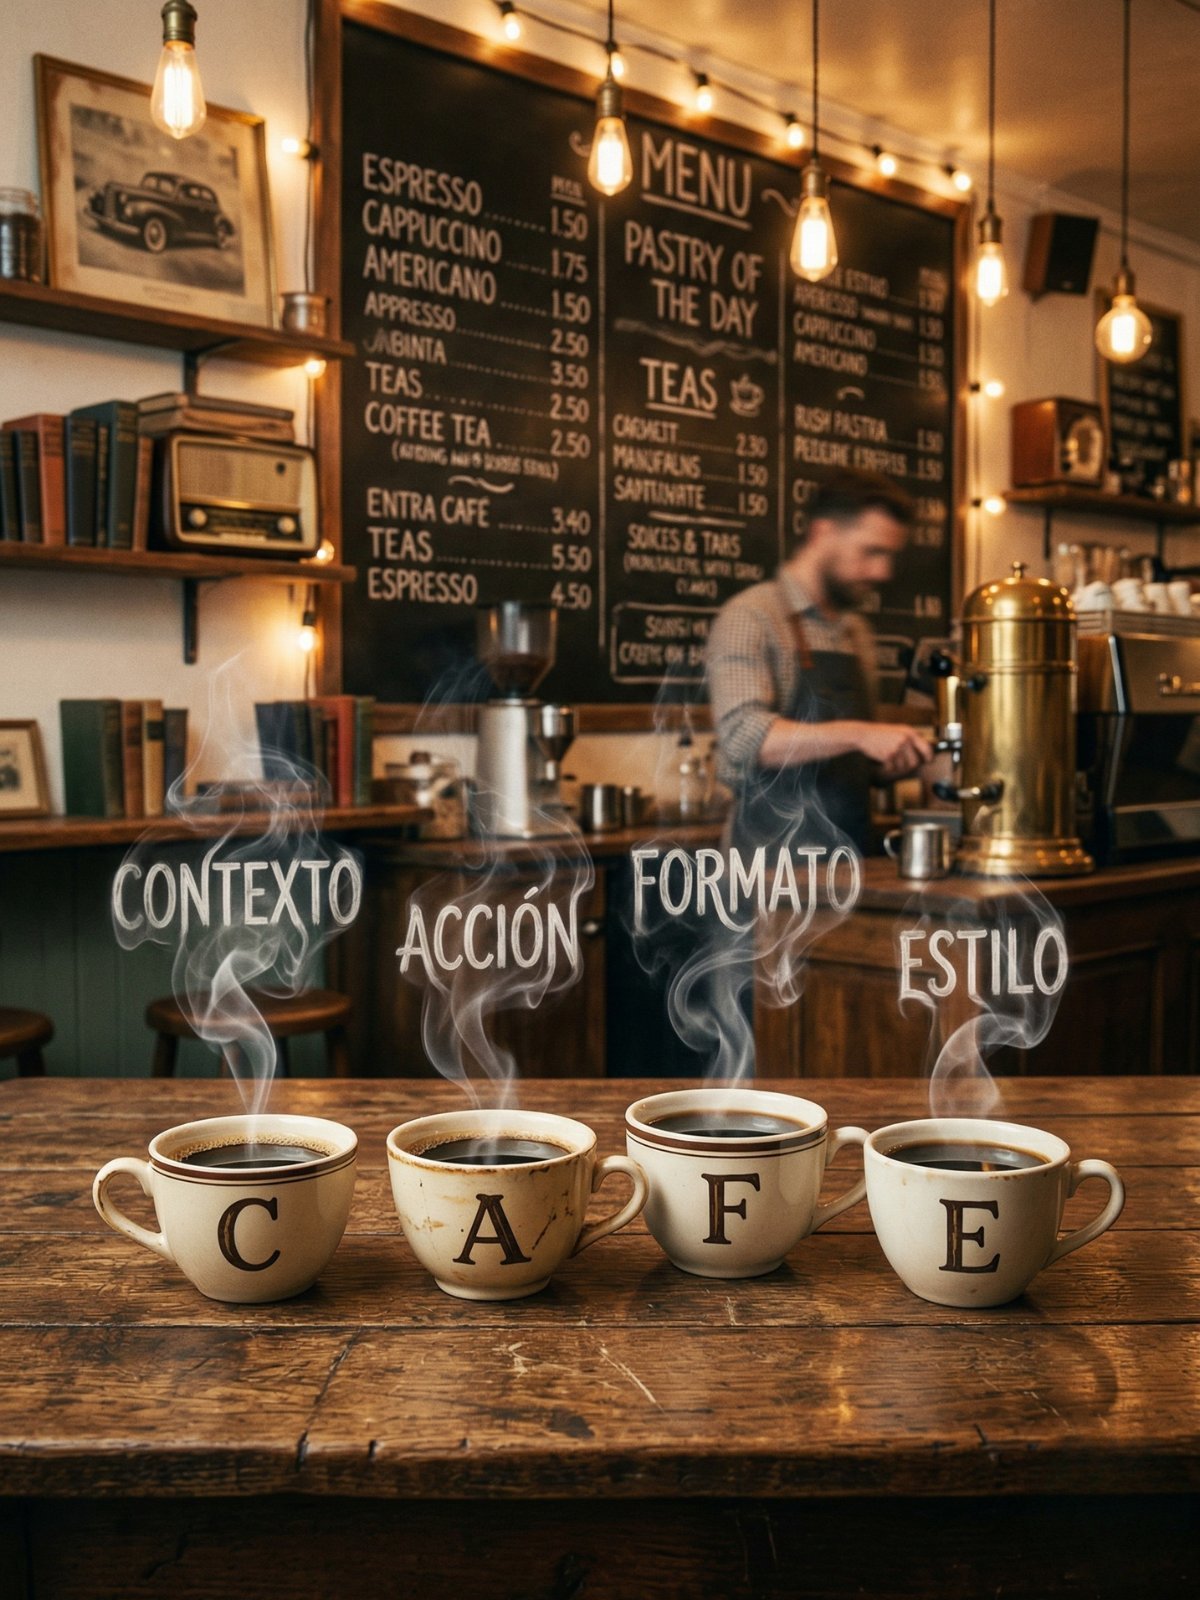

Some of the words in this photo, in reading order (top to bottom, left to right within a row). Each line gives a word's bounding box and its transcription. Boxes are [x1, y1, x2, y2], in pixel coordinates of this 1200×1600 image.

[362, 152, 483, 217] ESPRESSO
[551, 205, 589, 242] 1.50
[640, 130, 752, 218] MENU
[362, 199, 502, 264] CAPPUCCINO
[551, 248, 589, 284] 1.75
[624, 220, 725, 286] PASTRY
[731, 251, 764, 294] OF
[362, 243, 497, 305] AMERICANO
[551, 289, 592, 325] 1.50
[651, 277, 701, 328] THE
[708, 290, 759, 339] DAY
[363, 290, 457, 333] APPRESSO
[551, 328, 590, 359] 2.50
[365, 361, 424, 400] TEAS
[551, 392, 590, 423] 2.50
[551, 360, 590, 389] 3.50
[639, 356, 719, 411] TEAS
[365, 400, 446, 442] COFFEE
[450, 412, 492, 449] TEA
[551, 428, 592, 459] 2.50
[366, 486, 438, 525] ENTRA
[551, 506, 592, 536] 3.40
[366, 525, 435, 564] TEAS
[551, 542, 593, 573] 5.50
[367, 566, 479, 605] ESPRESSO
[551, 581, 593, 610] 4.50
[112, 857, 363, 935] CONTEXTO
[631, 845, 862, 935] FORMATO
[395, 886, 579, 975] ACCIÓN
[899, 926, 1070, 1002] ESTILO
[217, 1196, 281, 1272] C
[452, 1193, 532, 1266] A
[700, 1172, 762, 1245] F
[938, 1198, 1001, 1274] E
